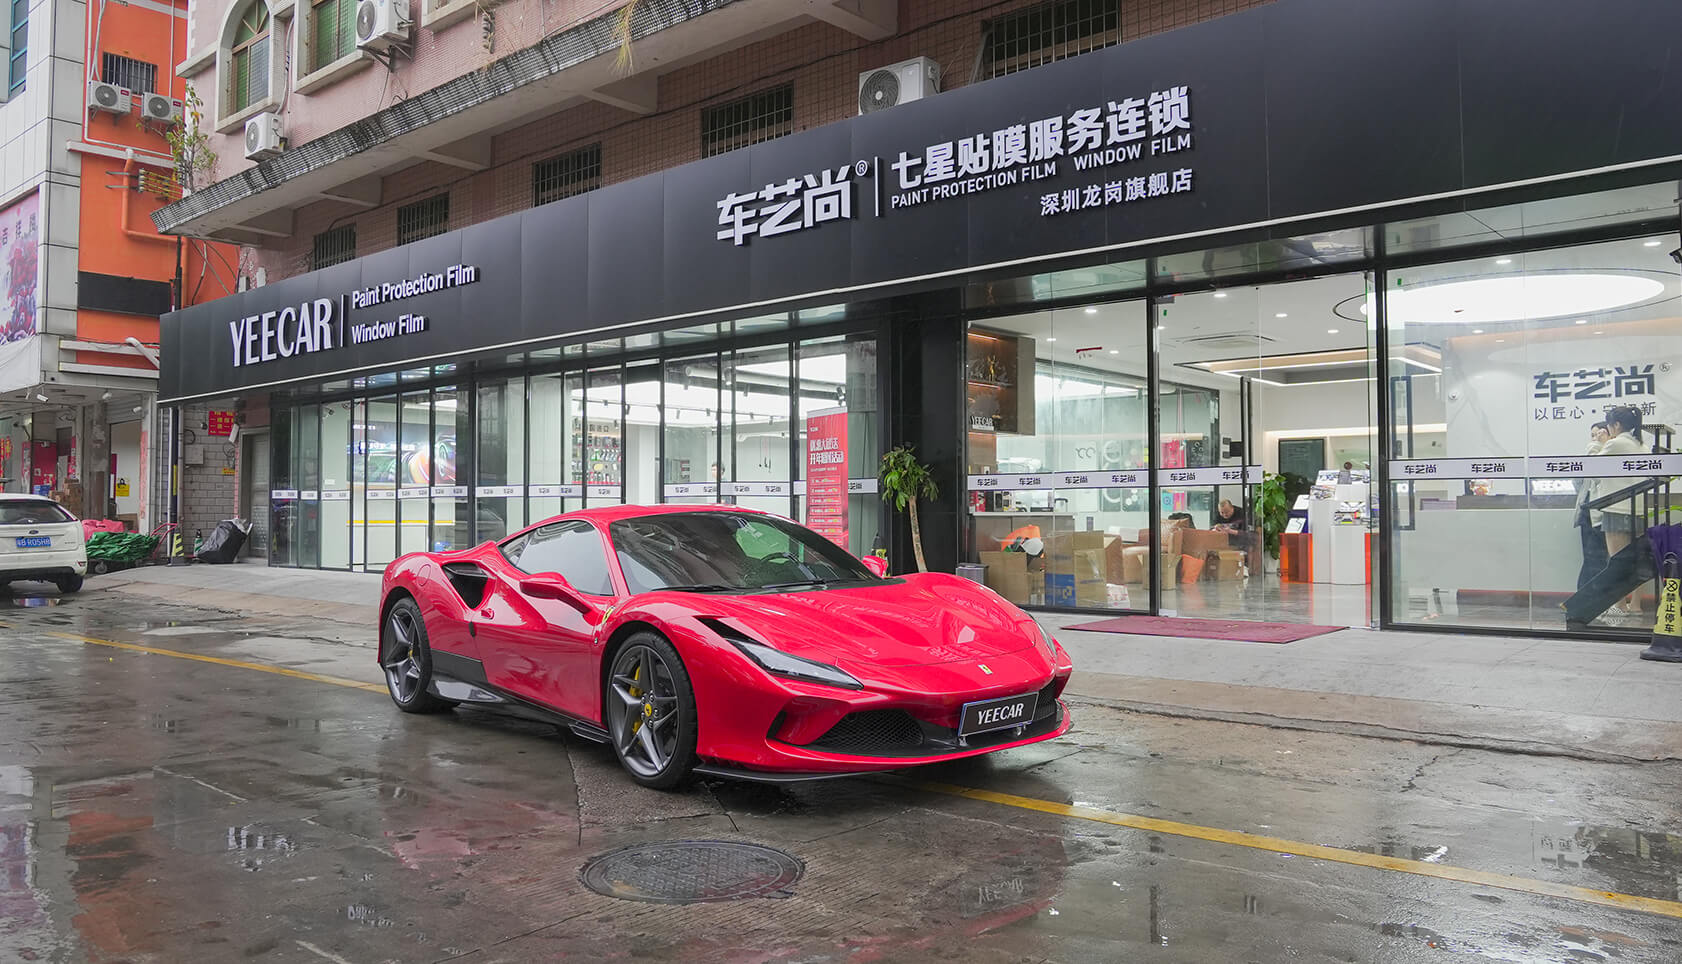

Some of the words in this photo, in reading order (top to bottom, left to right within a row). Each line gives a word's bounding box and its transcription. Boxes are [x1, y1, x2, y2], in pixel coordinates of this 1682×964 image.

[891, 85, 1191, 189] 七星贴膜服务连锁
[891, 188, 930, 209] PAINT
[932, 169, 1017, 200] PROTECTION
[1021, 161, 1057, 182] FILM
[1073, 143, 1142, 171] WINDOW
[1151, 133, 1191, 156] FILM
[716, 164, 851, 246] 车艺尚
[1040, 168, 1193, 216] 深圳龙岗旗舰店
[352, 286, 380, 310] Paint
[381, 272, 444, 302] Protection
[446, 264, 476, 288] Film
[229, 298, 333, 367] YEECAR
[351, 320, 396, 345] Window
[398, 313, 425, 335] Film
[1533, 364, 1656, 403] 车艺尚
[1111, 474, 1137, 484] 车艺尚
[1170, 472, 1197, 482] 车艺尚
[1403, 464, 1437, 475] 车艺尚
[1471, 463, 1506, 474] 车艺尚
[1546, 461, 1584, 473] 车艺尚
[1622, 460, 1663, 472] 车艺尚
[1664, 592, 1676, 633] 禁止停车
[977, 702, 1025, 726] YEECAR
